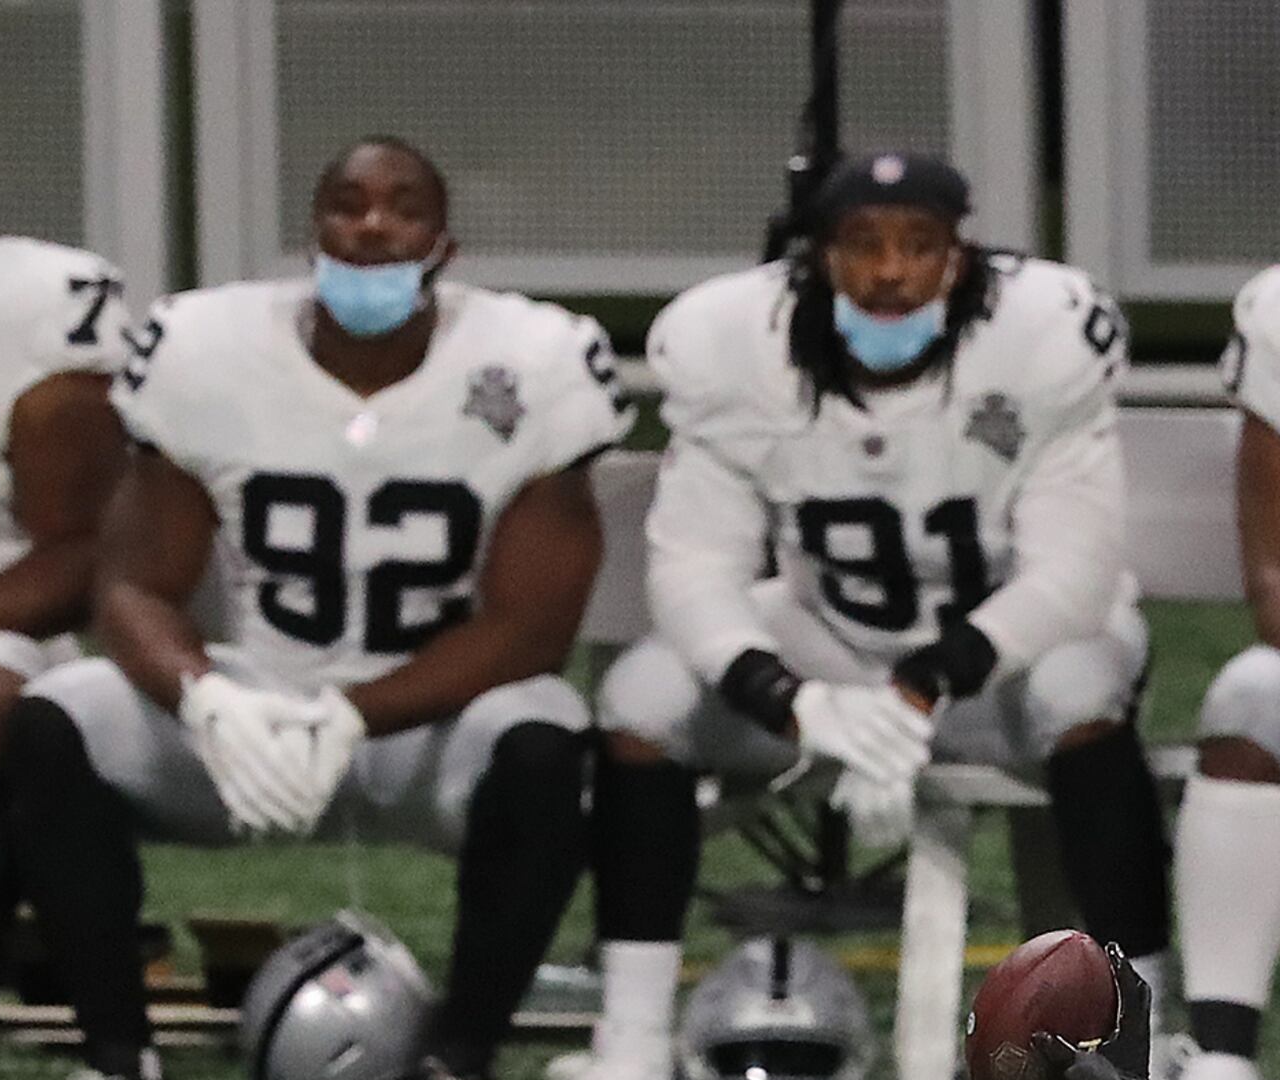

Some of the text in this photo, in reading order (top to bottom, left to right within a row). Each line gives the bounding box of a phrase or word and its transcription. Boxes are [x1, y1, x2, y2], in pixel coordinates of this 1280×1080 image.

[68, 273, 122, 346] 7
[242, 471, 482, 654] 92
[796, 497, 988, 631] 91
